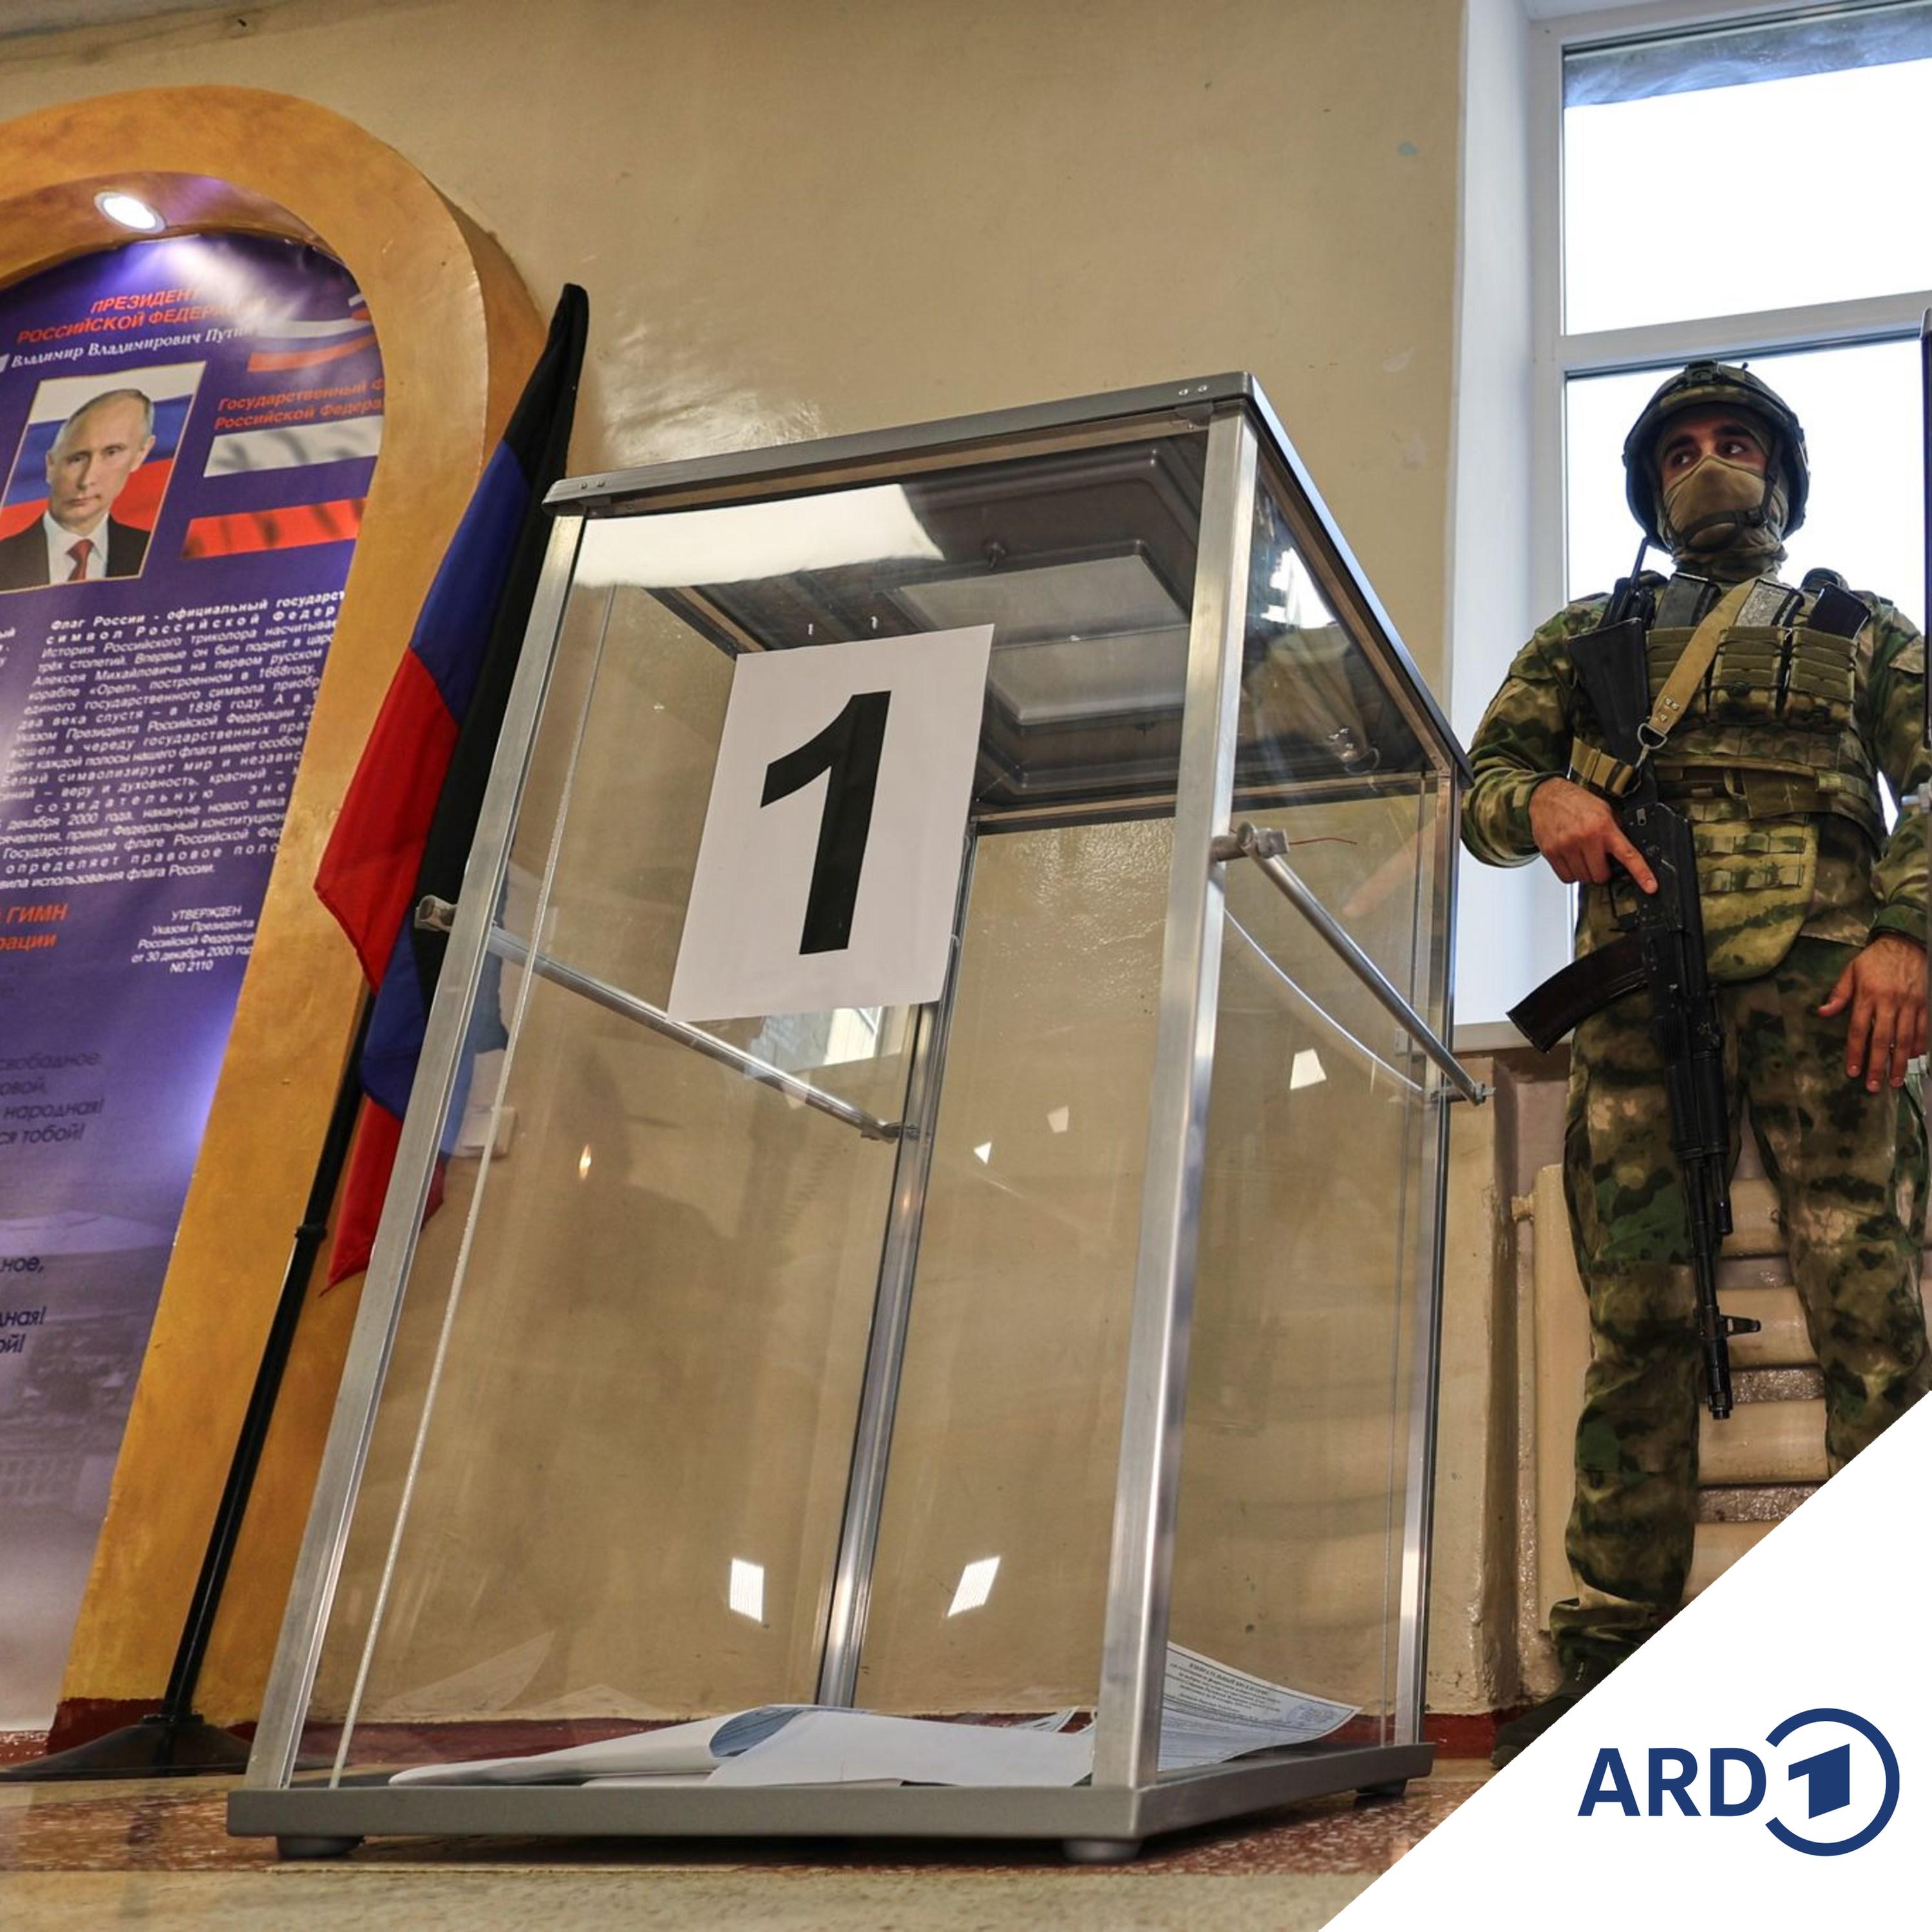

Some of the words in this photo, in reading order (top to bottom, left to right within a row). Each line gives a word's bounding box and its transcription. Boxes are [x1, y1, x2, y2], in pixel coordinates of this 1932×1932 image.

[91, 289, 199, 314] ПРЕЗИДЕН
[17, 312, 145, 345] РОССИЙСКОЙ
[149, 298, 266, 325] ФЕДЕРА
[12, 346, 83, 368] Владимир
[88, 334, 200, 357] Владимирович
[218, 381, 367, 411] Государственный
[214, 406, 314, 431] Российской
[46, 629, 122, 645] символ
[135, 614, 260, 637] Российской
[272, 605, 336, 621] Федер
[50, 618, 86, 630] Флаг
[93, 614, 146, 627] России
[167, 598, 268, 621] официальный
[41, 645, 95, 658] История
[103, 637, 182, 653] Российского
[191, 629, 257, 645] триколора
[134, 650, 187, 665] Впервые
[192, 648, 208, 658] он
[214, 644, 240, 656] был
[245, 639, 288, 652] поднят
[32, 674, 86, 687] Алексея
[95, 664, 182, 681] Михайловича
[190, 661, 206, 672] на
[214, 656, 263, 670] первом
[270, 649, 323, 665] русском
[24, 701, 76, 715] единого
[84, 690, 201, 711] государственного
[208, 683, 265, 698] символа
[28, 687, 80, 701] корабле
[149, 672, 232, 690] построенном
[17, 719, 43, 730] два
[52, 715, 87, 726] века
[96, 710, 144, 724] спустя
[189, 700, 222, 713] 1896
[66, 724, 139, 741] Президента
[147, 715, 218, 732] Российской
[226, 708, 295, 724] Федерации
[83, 740, 134, 752] череду
[143, 725, 270, 748] государственных
[279, 721, 310, 734] пра
[36, 757, 82, 769] каждой
[84, 753, 130, 766] полосы
[133, 747, 176, 761] нашего
[178, 746, 216, 759] флага
[219, 741, 256, 753] имеет
[259, 736, 303, 750] особое
[58, 764, 174, 782] символизирует
[183, 760, 213, 772] мир
[61, 786, 94, 798] веру
[209, 768, 266, 784] красный
[34, 790, 214, 813] созидательную
[249, 781, 287, 795] эне
[6, 815, 61, 830] декабря
[67, 813, 99, 826] 2000
[143, 804, 201, 819] накануне
[208, 800, 249, 813] нового
[256, 797, 285, 809] века
[761, 690, 891, 954] 1
[3, 842, 117, 860] Государственном
[124, 838, 164, 851] флаге
[173, 829, 249, 846] Российской
[66, 828, 109, 841] принят
[113, 819, 198, 837] Федеральный
[6, 855, 119, 874] определяет
[131, 847, 222, 866] правовое
[32, 871, 124, 887] использования
[126, 866, 166, 881] флага
[6, 903, 69, 924] ГИМН
[152, 925, 189, 935] Указом
[191, 919, 254, 932] Президента
[171, 905, 242, 921] УТВЕРЖДЕН
[131, 953, 144, 963] от
[146, 951, 160, 961] 30
[160, 947, 205, 961] декабря
[207, 945, 234, 957] 2000
[137, 935, 198, 949] Российской
[187, 960, 213, 972] 2110
[3, 1098, 104, 1121] народная!
[21, 1122, 86, 1144] тобой!
[0, 1256, 44, 1273] ное,
